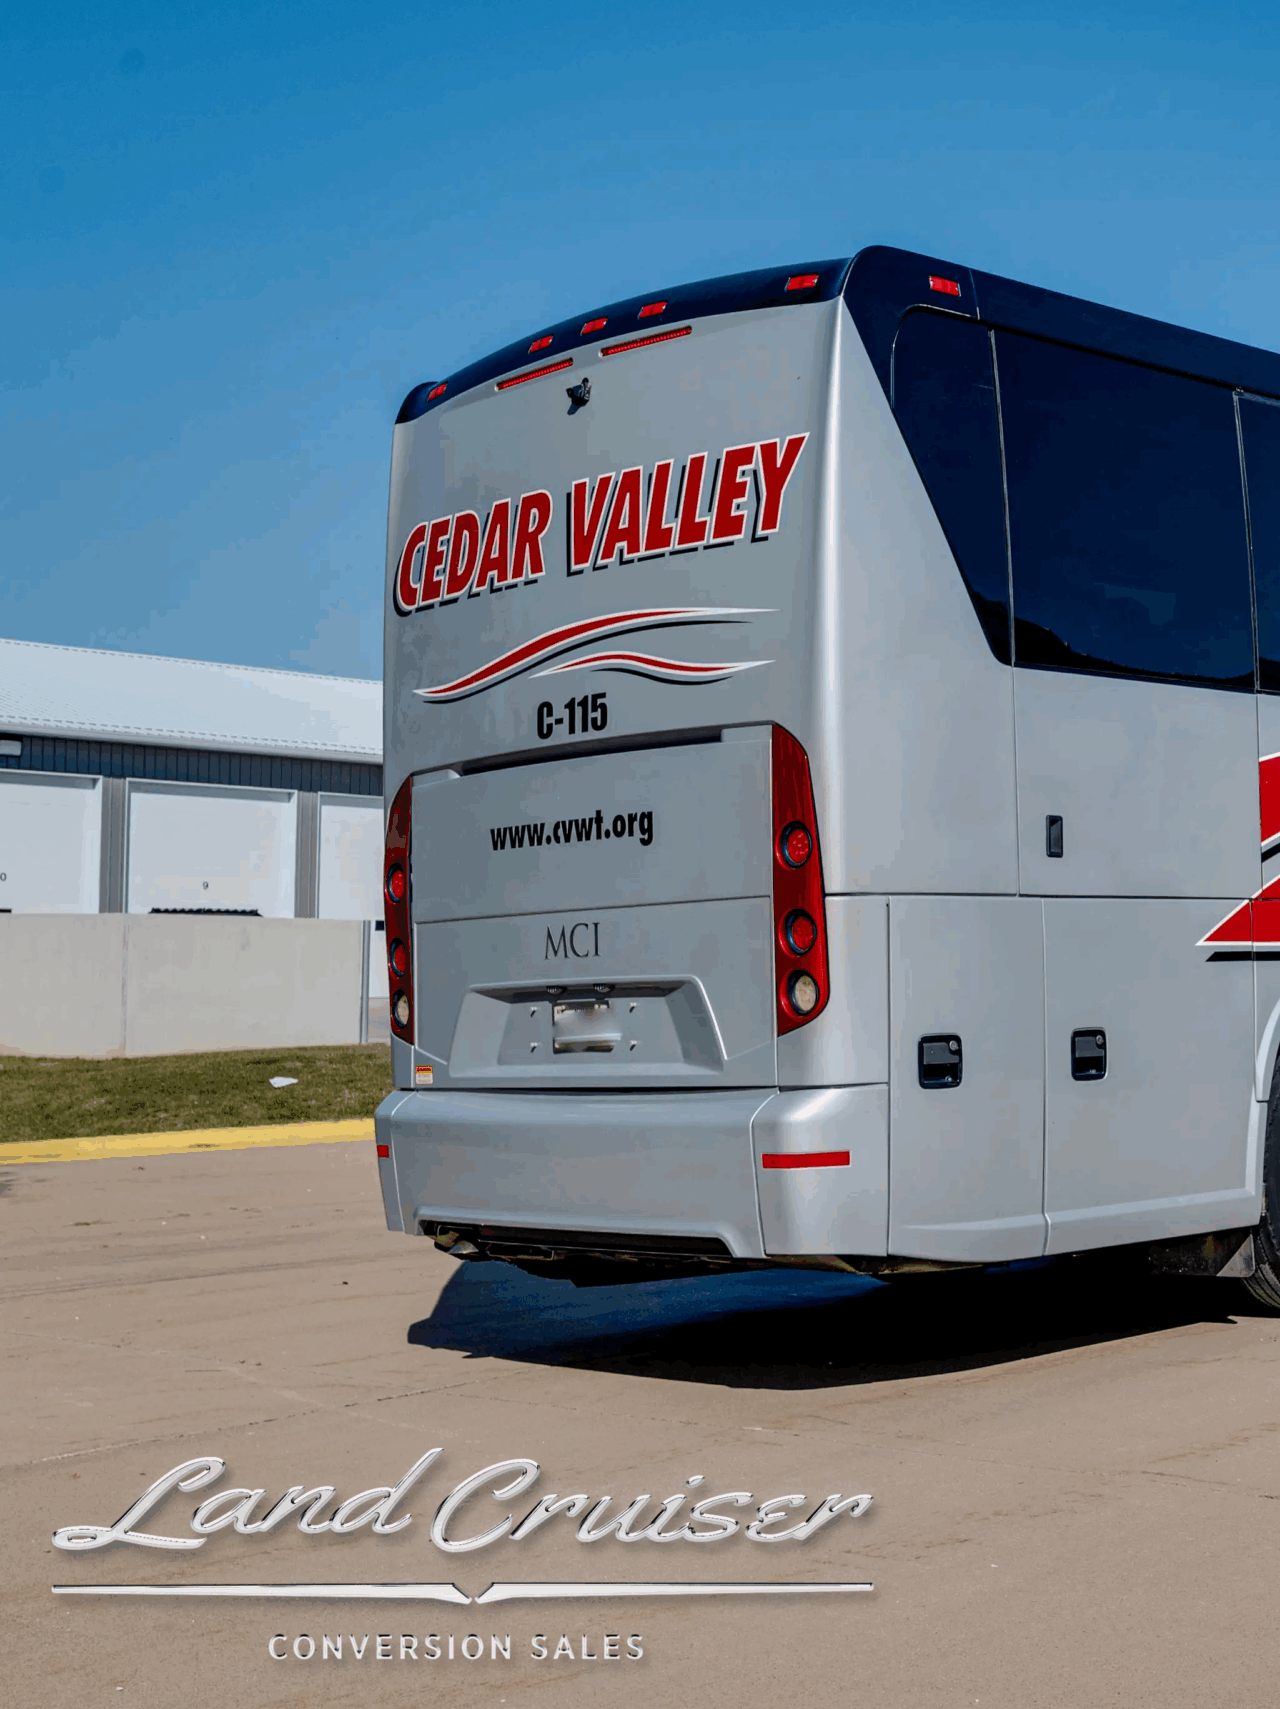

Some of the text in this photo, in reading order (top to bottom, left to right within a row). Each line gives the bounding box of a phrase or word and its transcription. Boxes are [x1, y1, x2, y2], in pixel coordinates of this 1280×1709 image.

[393, 432, 811, 617] CEDAR VALLEY
[536, 692, 608, 740] C-115
[490, 809, 653, 851] www.cvwt.org
[544, 922, 602, 960] MCI
